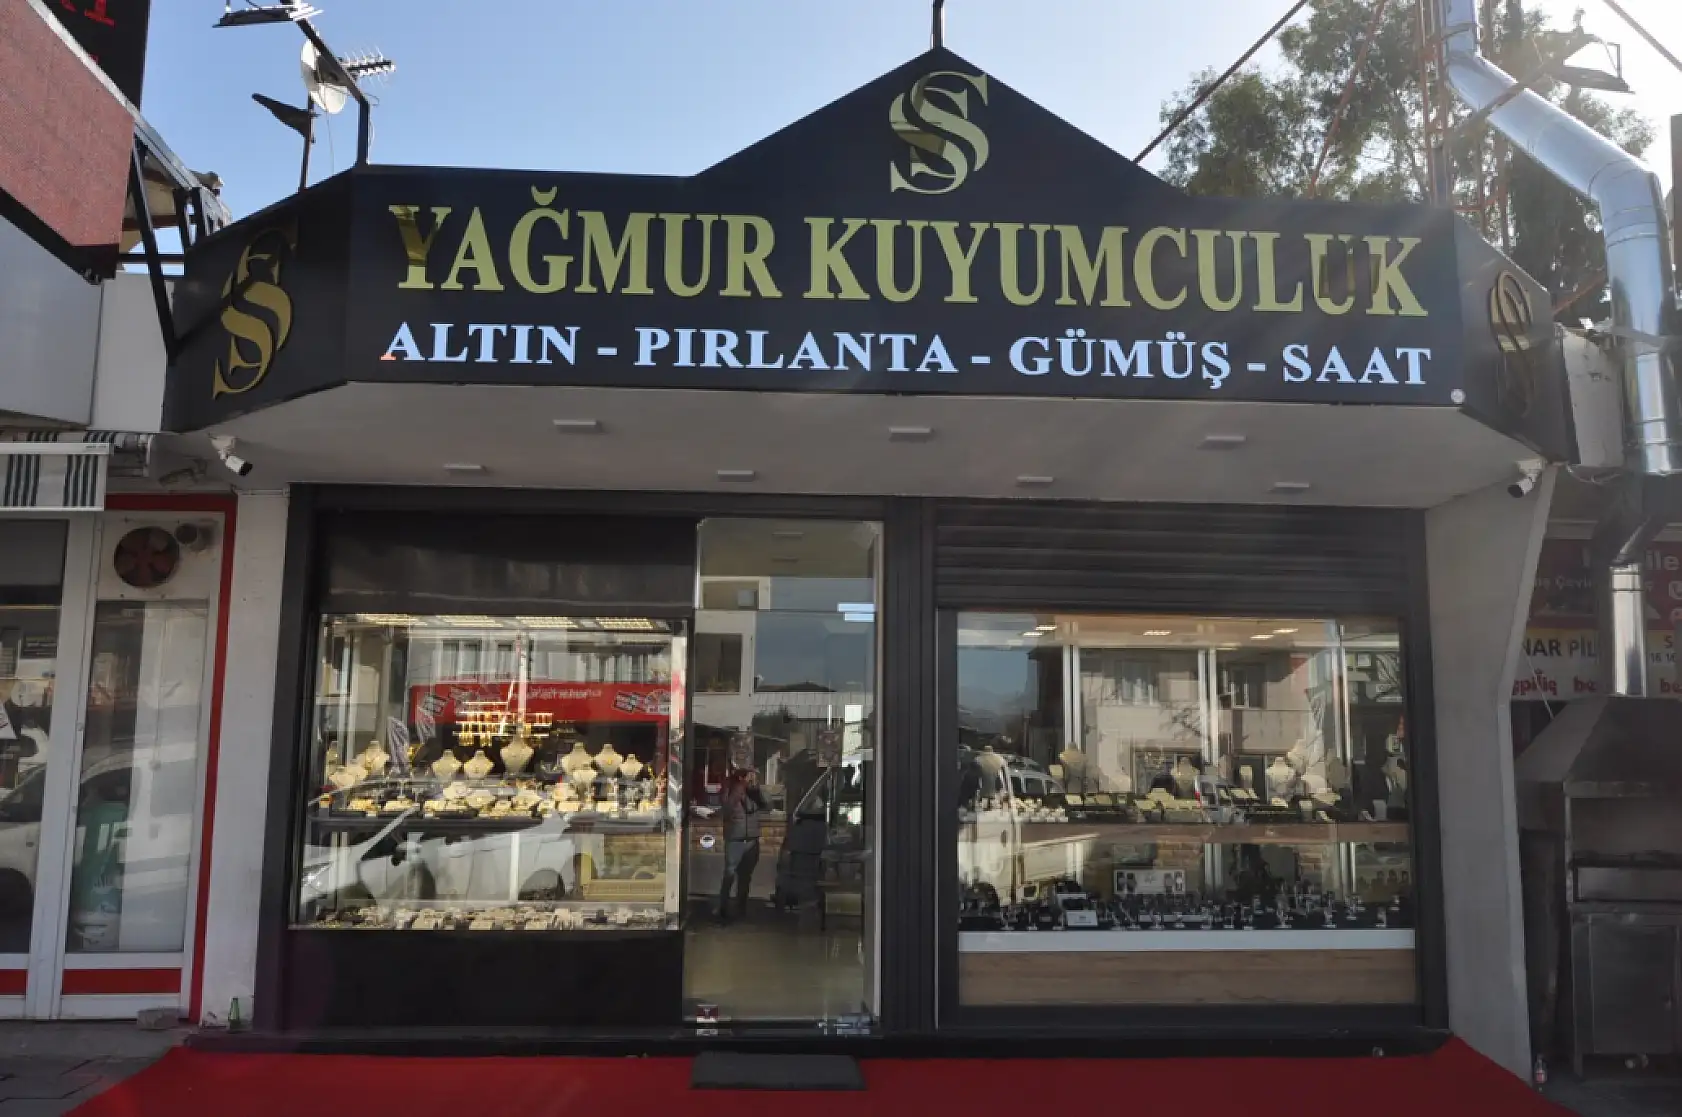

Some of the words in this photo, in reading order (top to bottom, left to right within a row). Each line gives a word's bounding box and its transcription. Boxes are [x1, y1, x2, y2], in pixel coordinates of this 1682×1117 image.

[388, 185, 782, 298] YAĞMUR
[803, 216, 1428, 317] KUYUMCULUK
[380, 321, 580, 365] ALTIN
[634, 325, 958, 376] PIRLANTA
[1009, 329, 1231, 389] GÜMÜŞ
[1283, 344, 1431, 385] SAAT
